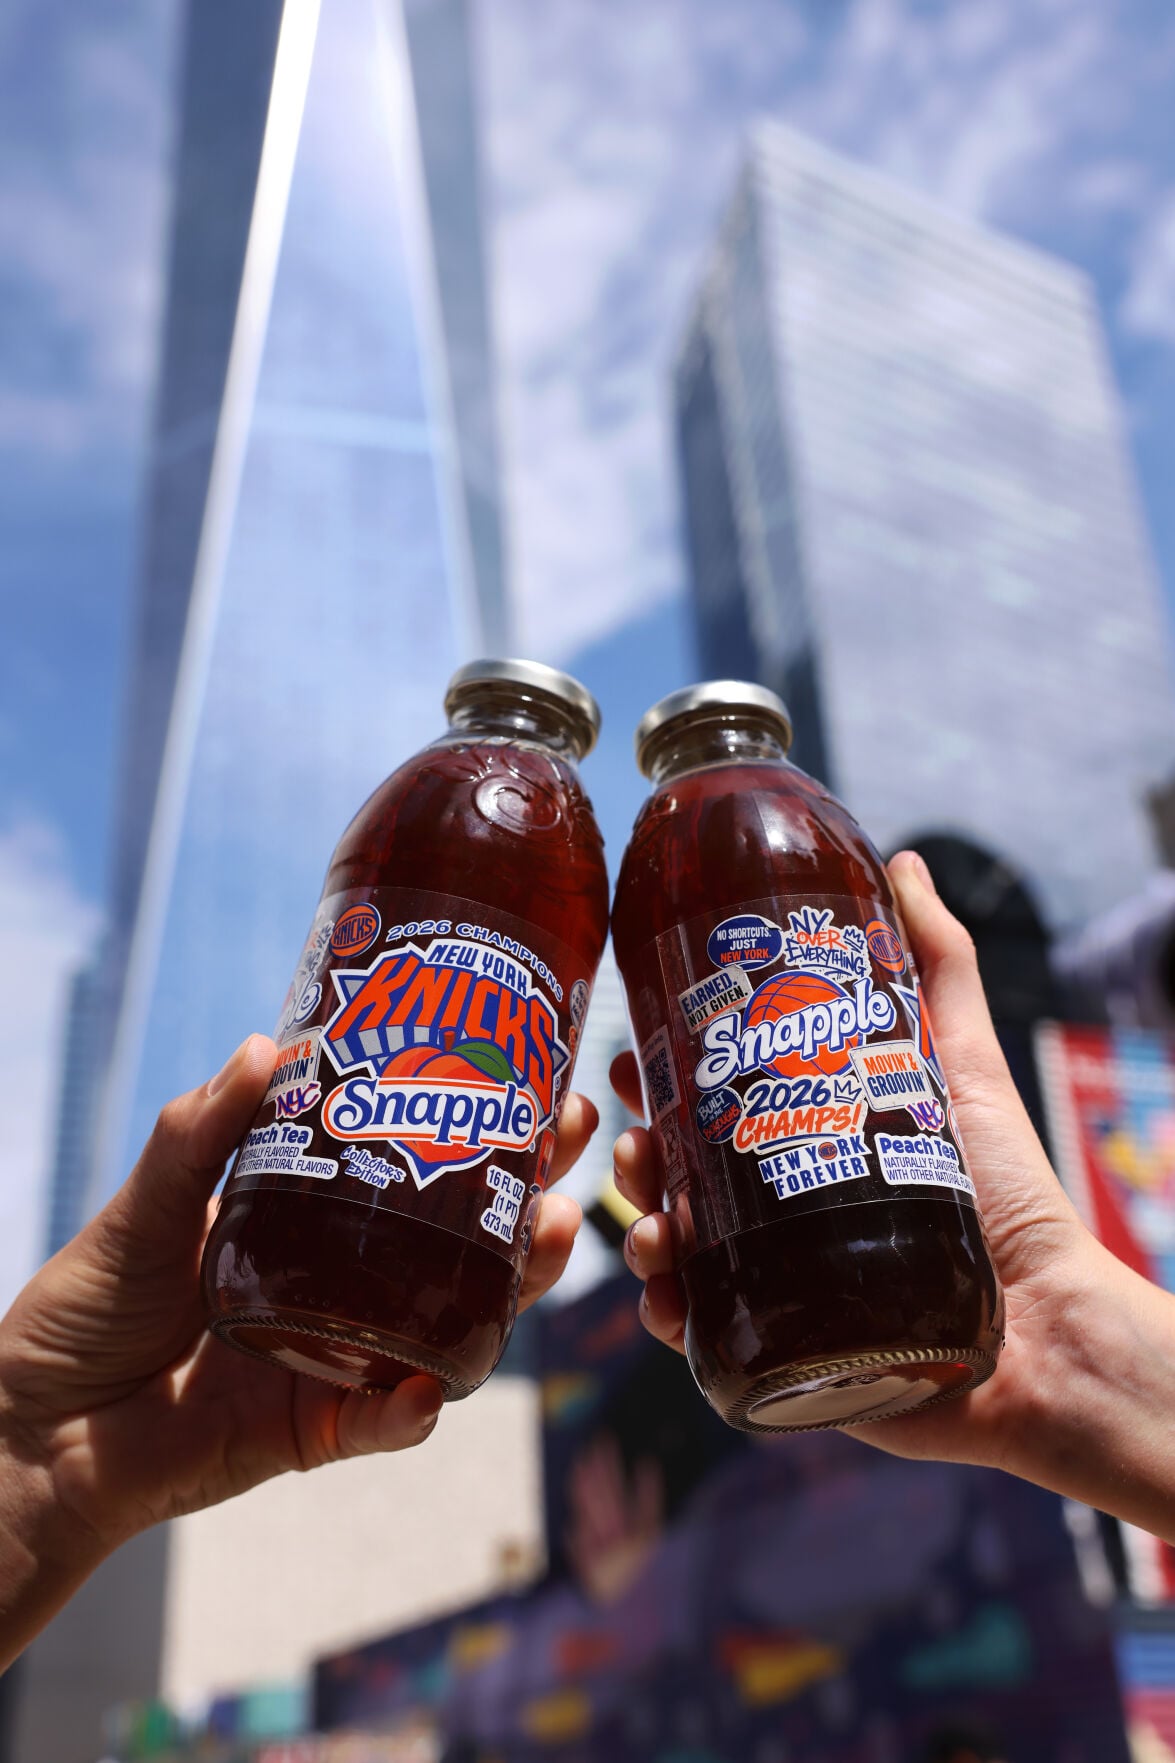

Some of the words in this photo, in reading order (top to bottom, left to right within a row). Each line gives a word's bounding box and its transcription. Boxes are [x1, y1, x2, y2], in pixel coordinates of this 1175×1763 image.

[334, 917, 373, 946] KNICKS
[717, 930, 727, 940] NO
[728, 927, 771, 940] SHORTCUTS.
[790, 909, 829, 935] NY
[730, 938, 757, 950] JUST
[797, 929, 848, 950] OVER
[388, 921, 450, 941] 2026
[457, 923, 563, 1001] CHAMPIONS
[720, 950, 743, 963] NEW
[744, 947, 772, 960] YORK.
[427, 944, 479, 968] NEW
[482, 951, 527, 997] YORK
[683, 972, 737, 1014] EARNED.
[688, 1003, 709, 1027] NOT
[711, 984, 748, 1012] GIVEN.
[327, 955, 553, 1117] KNICKS
[694, 977, 897, 1092] Snapple
[863, 1052, 907, 1076] MOVIN'
[908, 1052, 918, 1071] &
[745, 1078, 832, 1118] 2026
[867, 1071, 926, 1098] GROOVIN'
[277, 1082, 319, 1117] NYC
[333, 1079, 532, 1146] Snapple
[698, 1091, 725, 1121] BUILT
[906, 1098, 944, 1130] NYC
[281, 1126, 310, 1145] Tea
[735, 1103, 863, 1150] CHAMPS!
[264, 1146, 300, 1158] FLAVORED
[879, 1137, 934, 1155] Peach
[934, 1139, 957, 1161] Tea
[884, 1156, 927, 1169] NATURALLY
[264, 1158, 294, 1170] NATURAL
[296, 1159, 334, 1176] FLAVORS
[760, 1150, 801, 1181] NEW
[774, 1156, 865, 1198] FOREVER
[887, 1169, 909, 1181] WITH
[910, 1169, 934, 1181] OTHER
[489, 1168, 501, 1186] 16
[501, 1176, 511, 1194] FL
[512, 1183, 524, 1201] OZ
[483, 1211, 501, 1232] 473
[495, 1194, 504, 1213] (1
[504, 1201, 519, 1223] PT)
